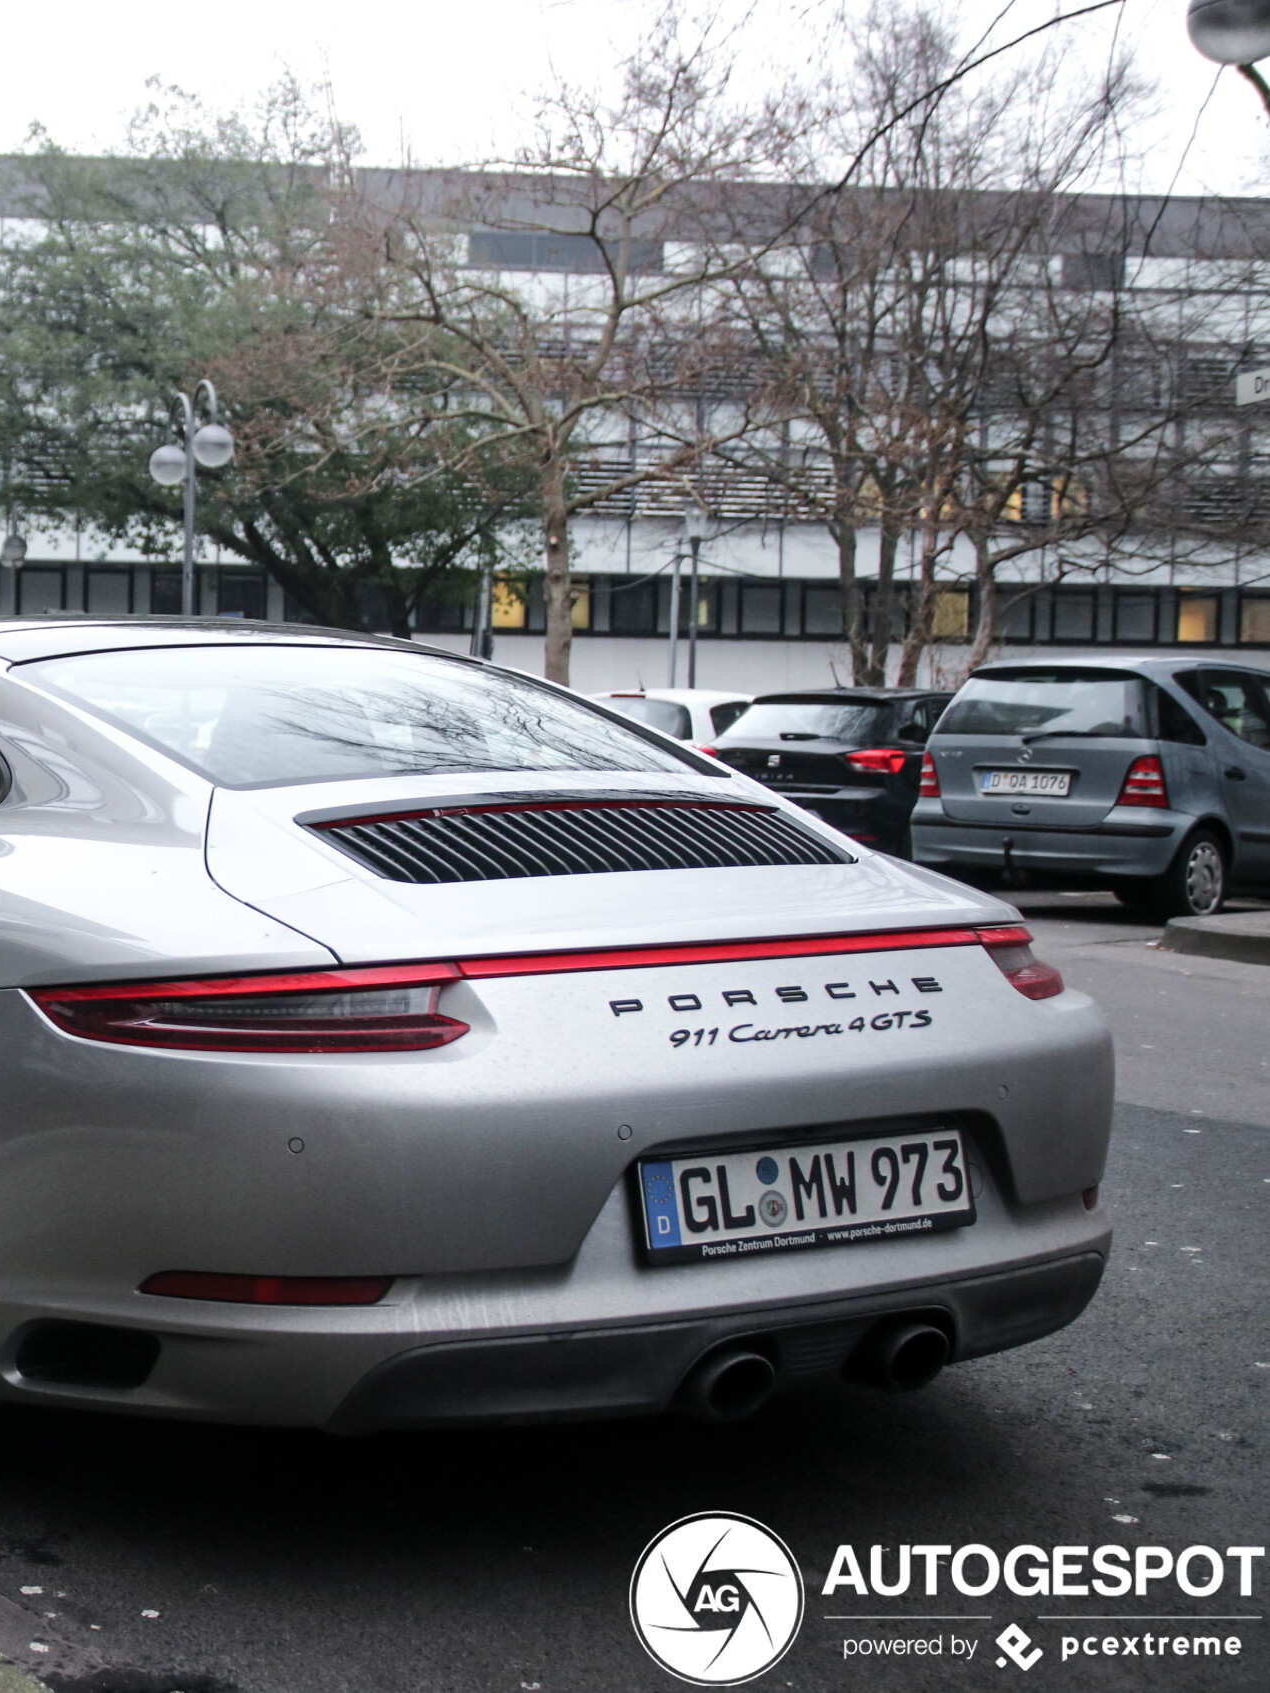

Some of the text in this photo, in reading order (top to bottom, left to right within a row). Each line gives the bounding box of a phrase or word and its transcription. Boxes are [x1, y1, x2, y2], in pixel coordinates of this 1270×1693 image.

[991, 774, 1001, 787] D
[1031, 775, 1067, 790] 1076
[609, 976, 943, 1017] PORSCHE
[669, 1027, 719, 1048] 911
[729, 1023, 844, 1043] Carrera
[681, 1138, 965, 1233] GL MW 973
[657, 1215, 671, 1235] D
[702, 1218, 933, 1256] Porsche Zentrum Dortmund www.porsche-dortmund.de
